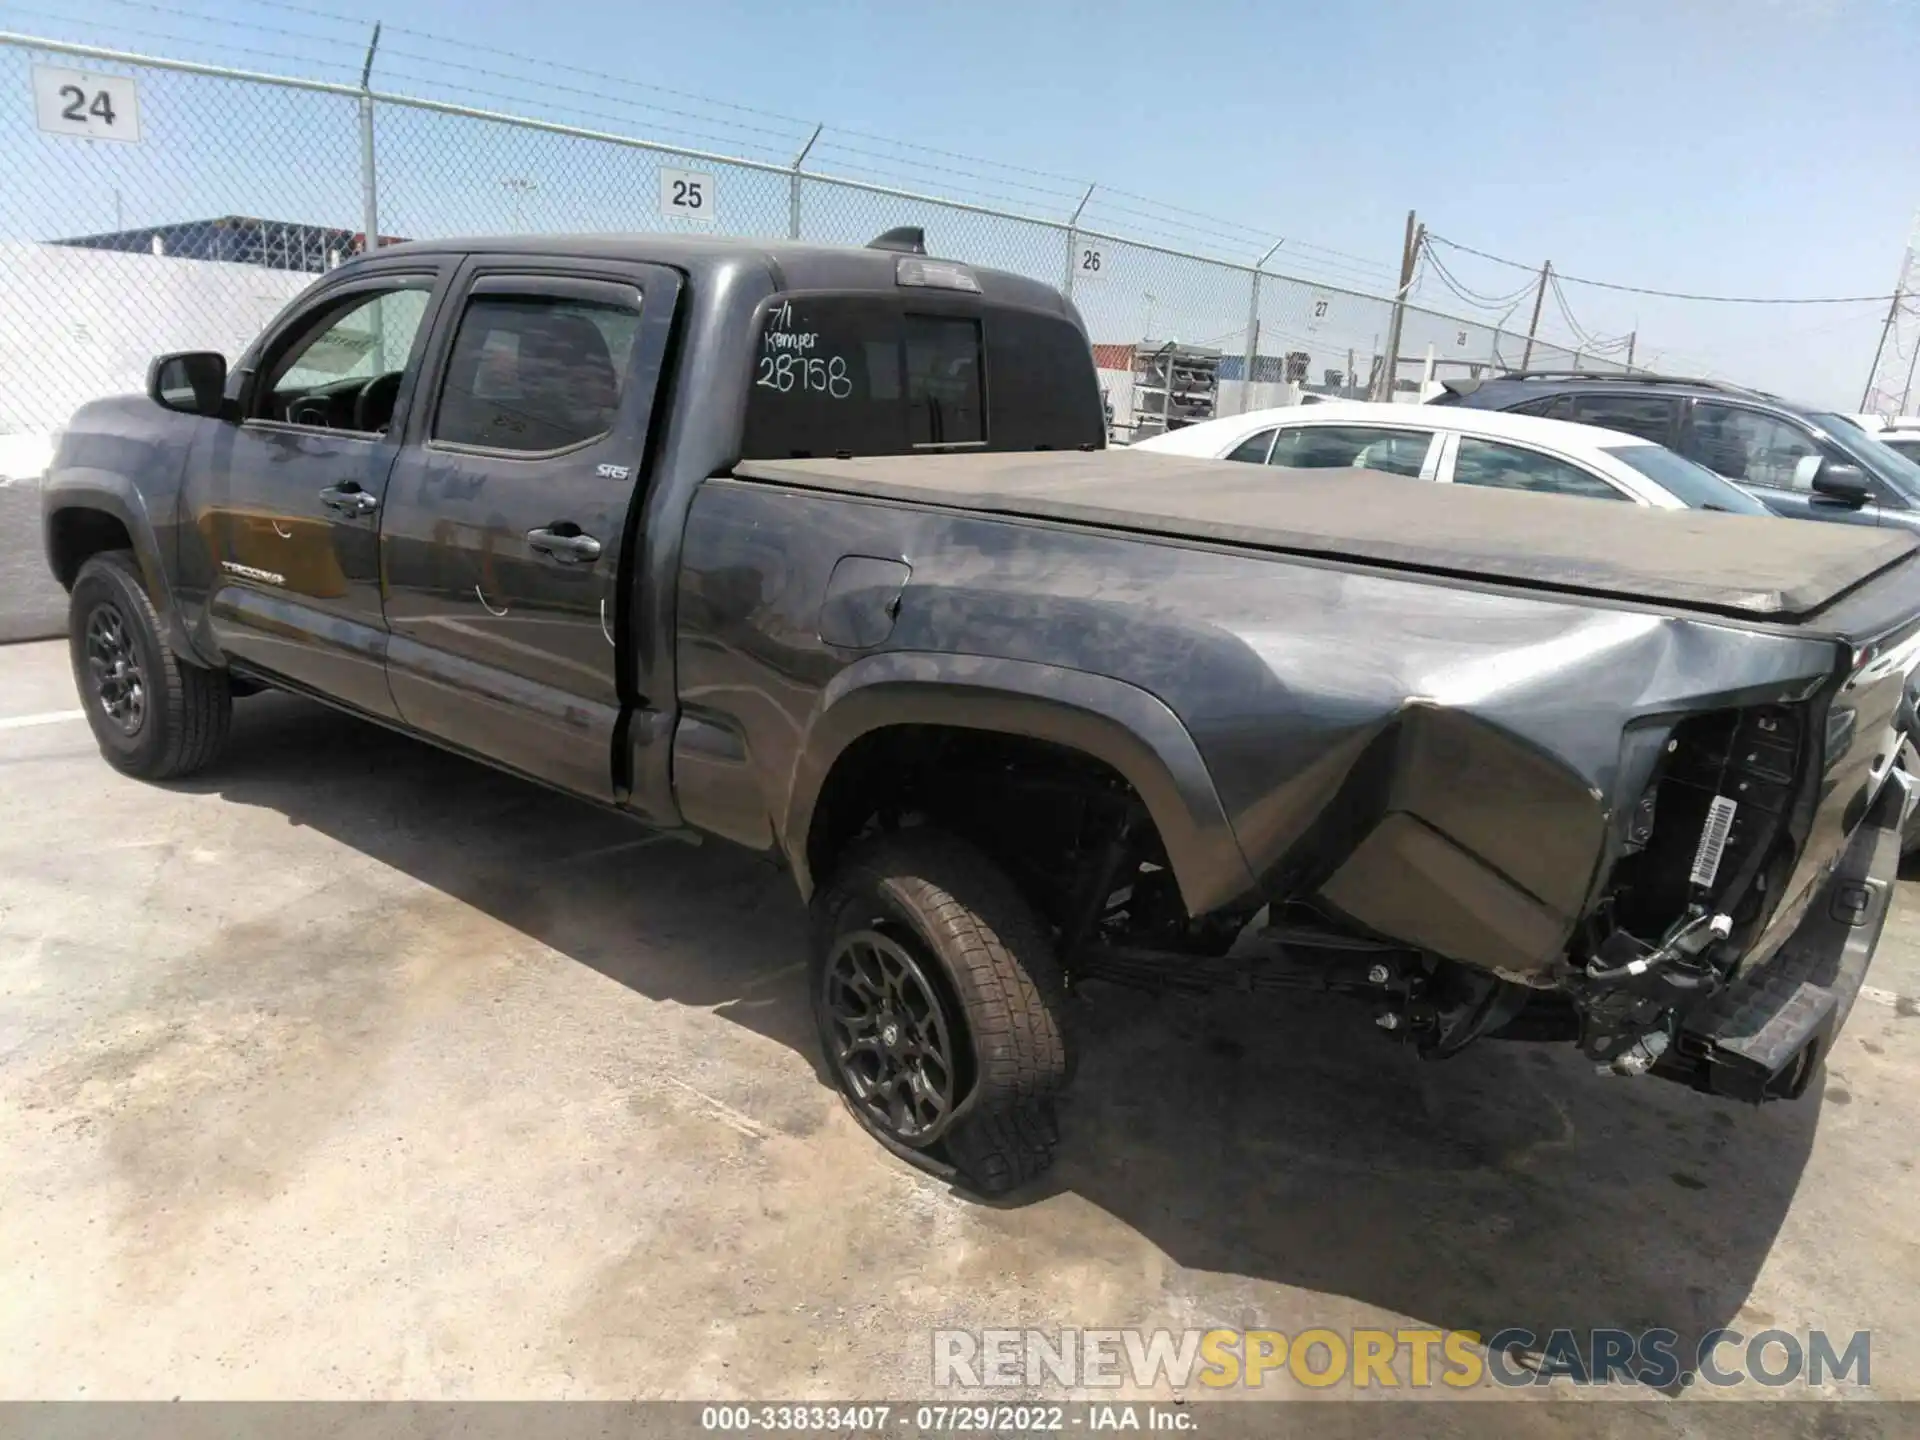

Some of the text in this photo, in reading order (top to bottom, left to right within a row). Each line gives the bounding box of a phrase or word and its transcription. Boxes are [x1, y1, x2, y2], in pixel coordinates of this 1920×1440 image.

[59, 84, 117, 126] 24
[672, 179, 702, 209] 25
[1082, 249, 1101, 272] 26
[768, 299, 792, 331] 7/1
[1315, 300, 1328, 318] 27
[756, 353, 852, 399] 28758
